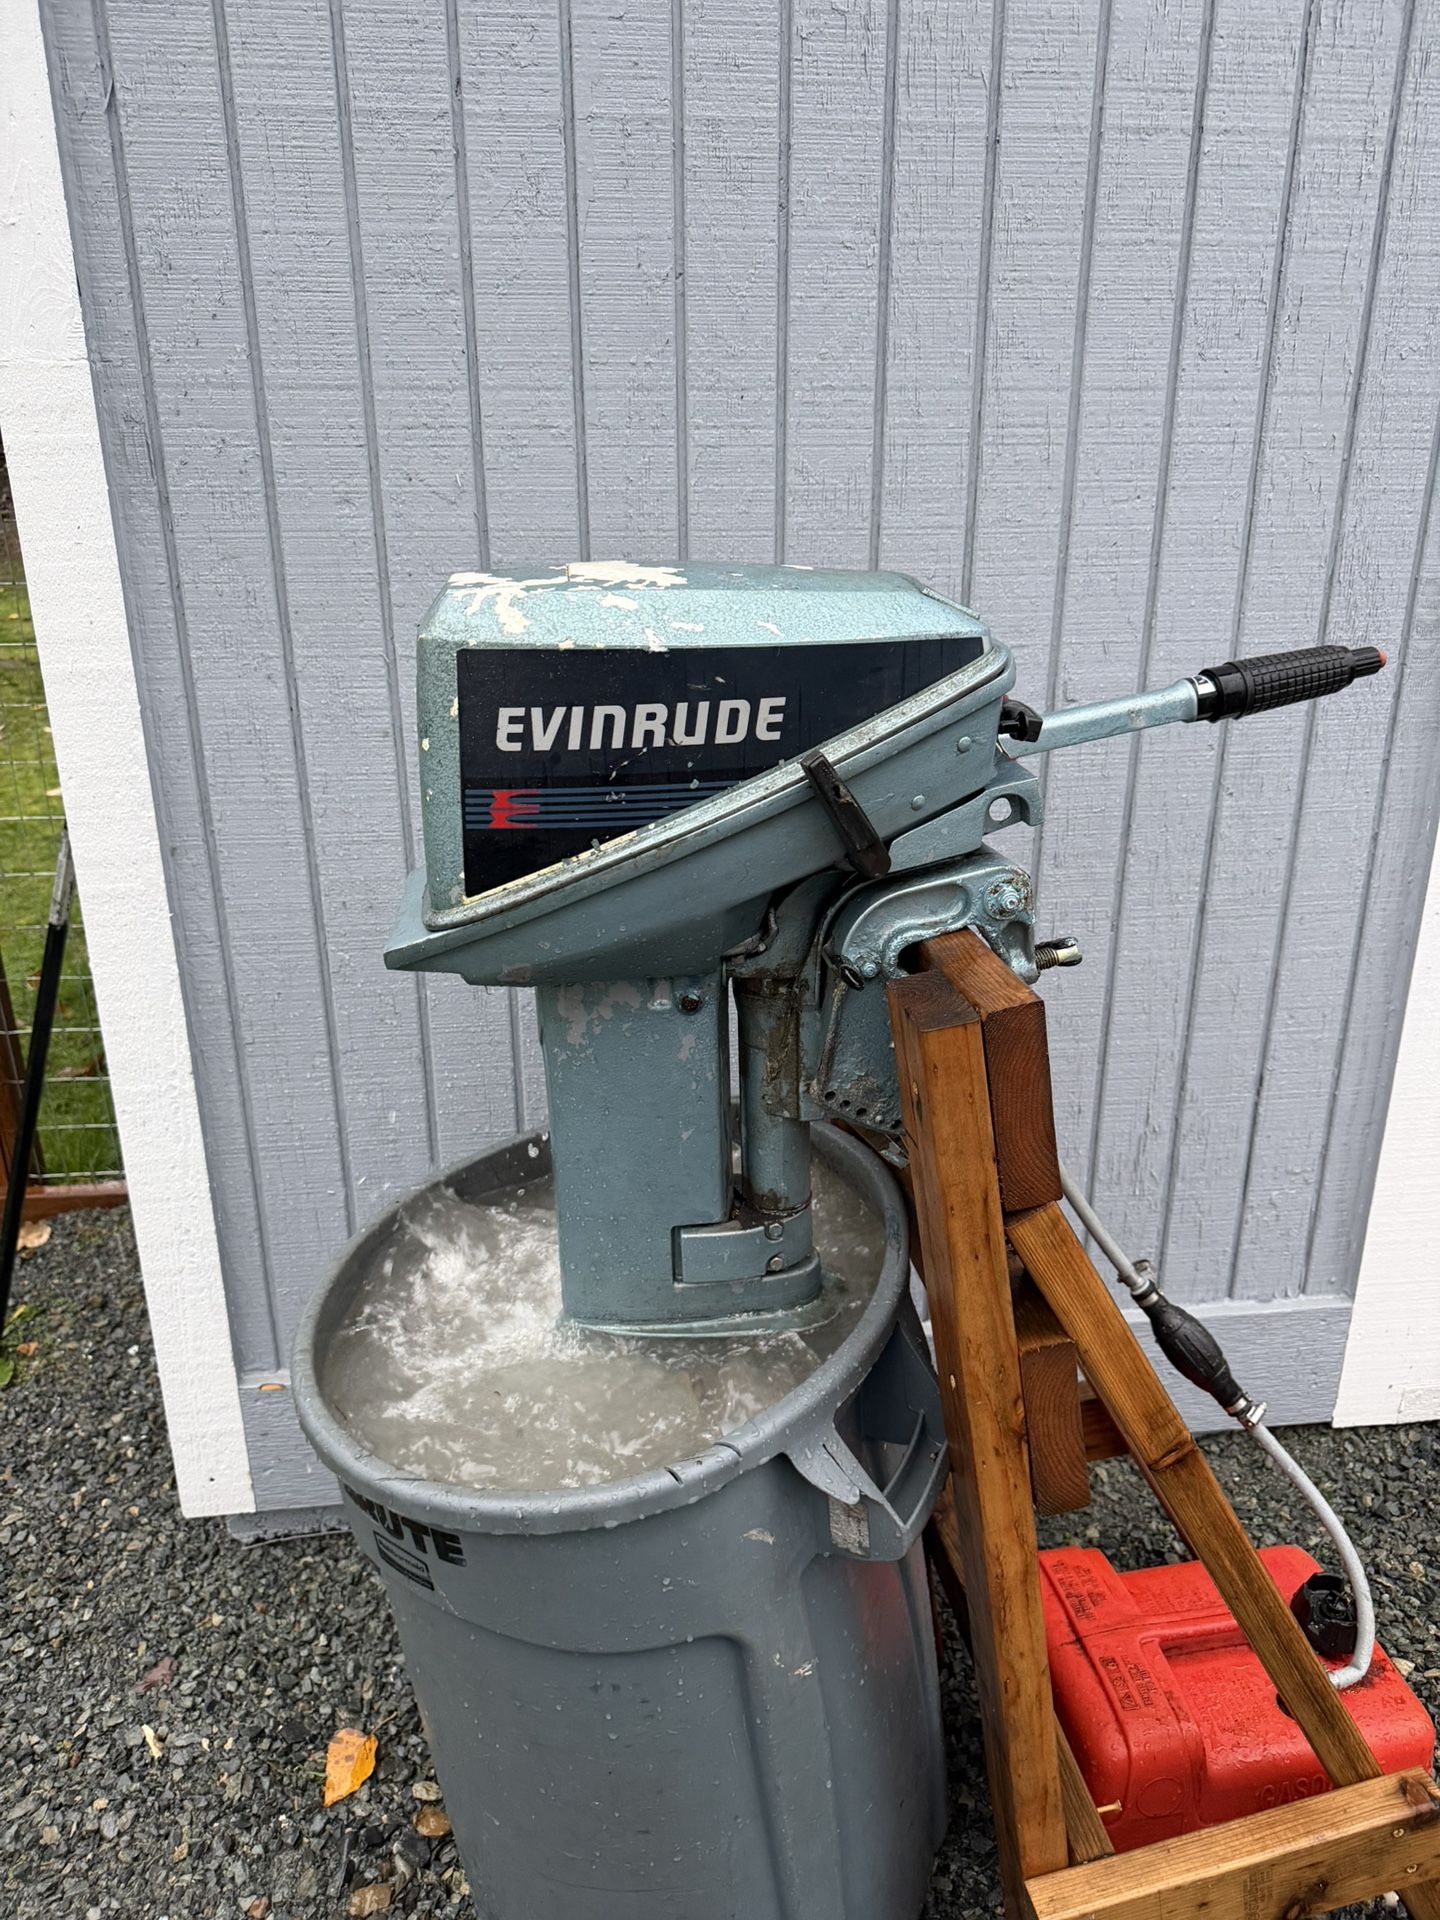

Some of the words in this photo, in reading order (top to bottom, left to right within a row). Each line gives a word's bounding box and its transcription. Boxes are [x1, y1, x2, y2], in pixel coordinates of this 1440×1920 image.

[496, 697, 787, 752] EVINRUDE
[343, 1483, 468, 1567] RUTE
[1260, 1773, 1334, 1807] GASO
